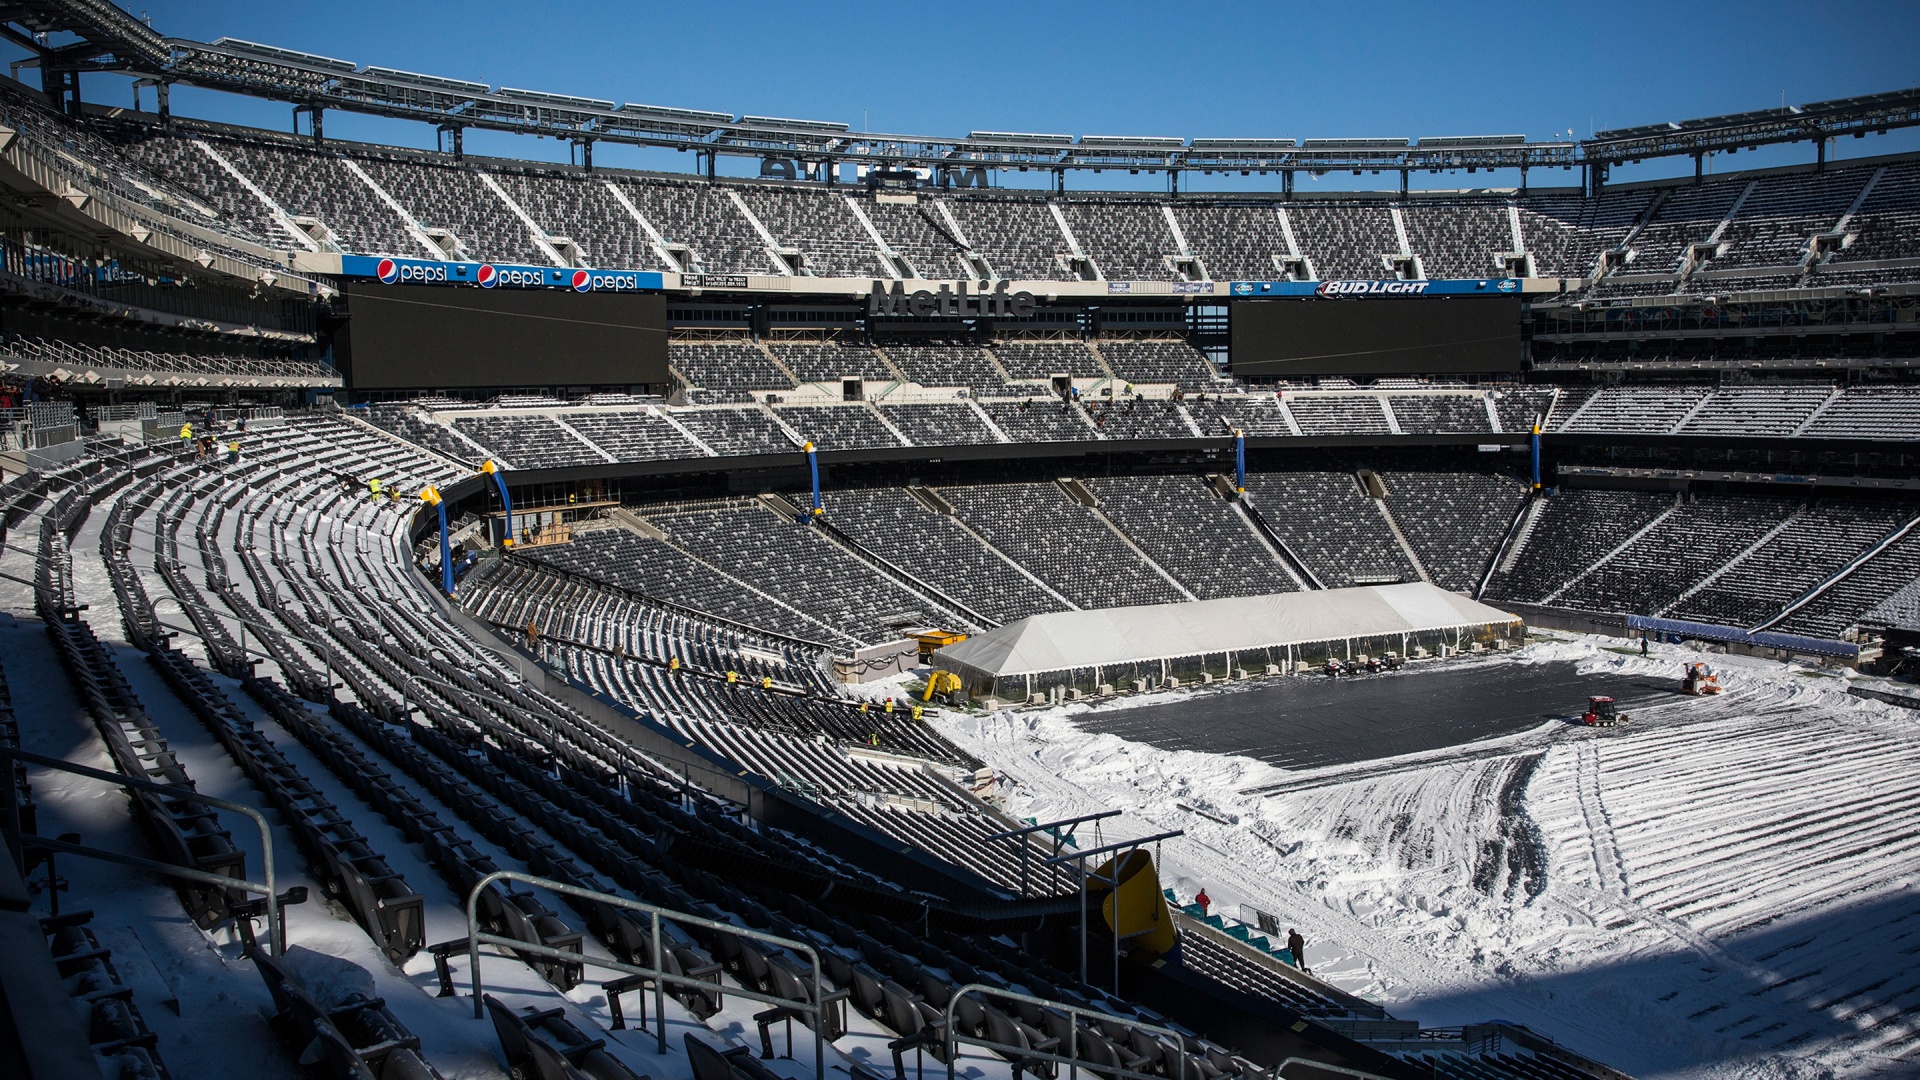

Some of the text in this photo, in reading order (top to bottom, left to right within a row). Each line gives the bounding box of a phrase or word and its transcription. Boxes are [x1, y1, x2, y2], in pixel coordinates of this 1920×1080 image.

[401, 264, 447, 284] pepsi
[499, 269, 545, 288] pepsi
[593, 273, 638, 292] pepsi
[1324, 281, 1429, 294] BUD LIGHT
[869, 279, 1036, 317] MetLife
